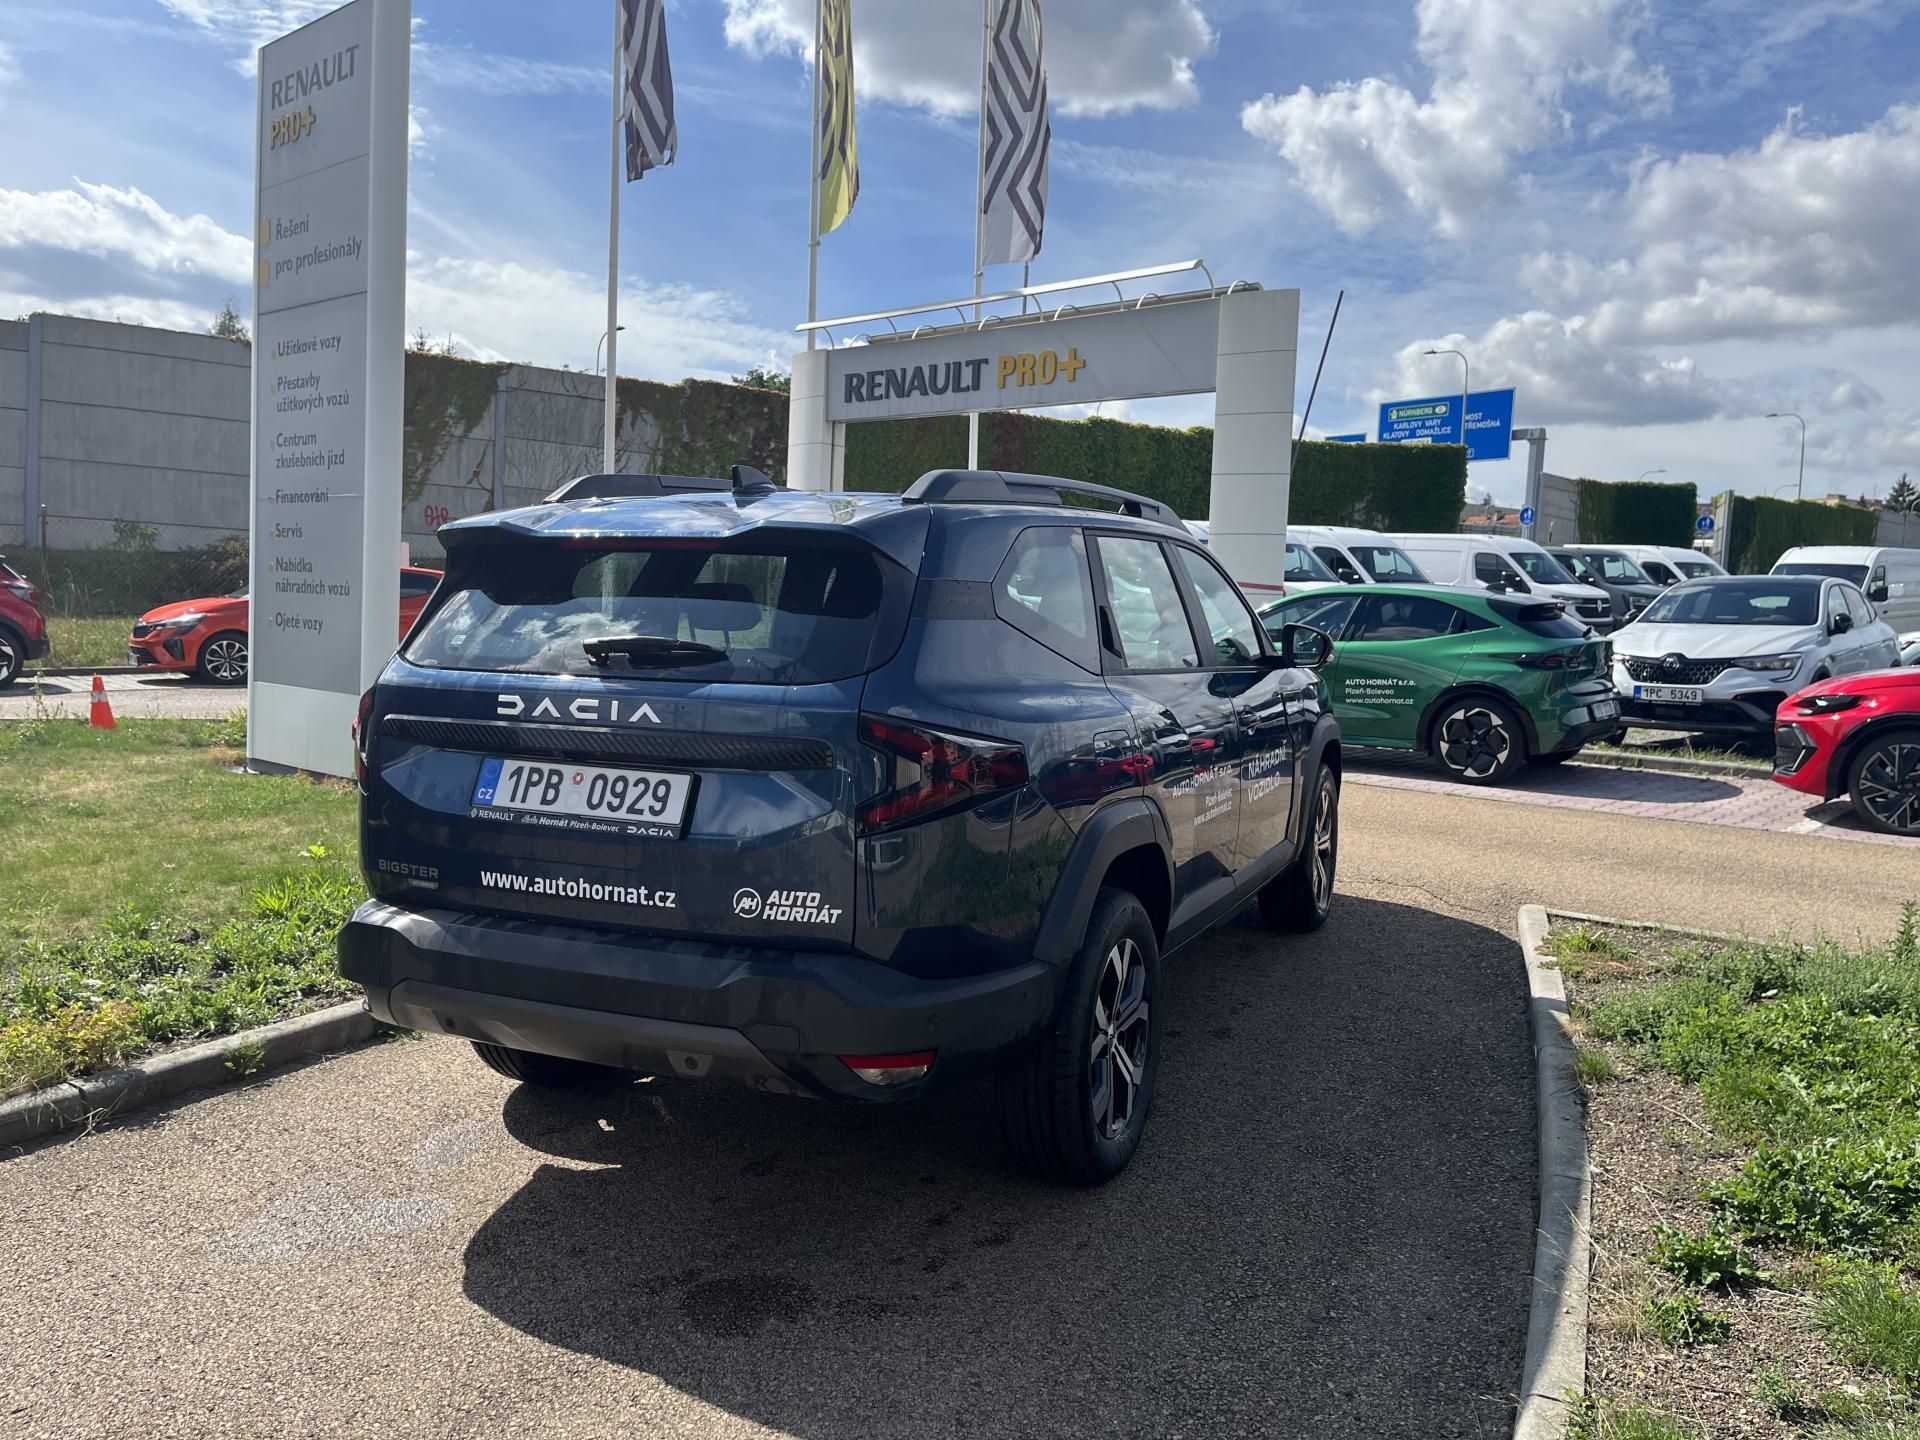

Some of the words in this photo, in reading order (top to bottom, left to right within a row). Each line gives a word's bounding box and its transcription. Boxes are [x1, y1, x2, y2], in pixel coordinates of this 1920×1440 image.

[271, 44, 360, 110] RENAULT
[269, 105, 316, 150] PRO+
[276, 213, 310, 240] Řešení
[275, 259, 293, 280] pro
[295, 236, 362, 275] profesionály
[277, 336, 318, 356] Užitkové
[320, 336, 341, 352] vozy
[277, 371, 321, 392] Přestavby
[844, 358, 989, 402] RENAULT
[996, 347, 1086, 388] PRO+
[276, 392, 324, 414] užitkových
[326, 388, 350, 407] vozů
[1398, 406, 1433, 417] NÜRNBERG
[1393, 420, 1423, 430] KARLOVY
[1424, 418, 1442, 427] VARY
[276, 433, 317, 448] Centrum
[1382, 430, 1410, 440] KLATOVY
[275, 450, 325, 469] zkušebních
[276, 487, 329, 504] Financování
[275, 523, 303, 538] Servis
[275, 578, 326, 595] náhradních
[327, 581, 350, 597] vozů
[275, 612, 300, 632] Ojeté
[302, 619, 323, 636] vozy
[1345, 687, 1395, 695] Plzeň-Bolevec
[1366, 678, 1398, 686] HORNÁT
[1643, 688, 1663, 699] 1PC
[1670, 690, 1697, 701] 5349
[497, 694, 662, 724] DACIA
[1248, 739, 1287, 780] NÁHRADNÍ
[508, 765, 564, 806] 1PB
[586, 773, 672, 817] 0929
[1172, 778, 1190, 800] AUTO
[1190, 764, 1218, 790] HORNÁT
[1247, 770, 1280, 804] VOZIDLO
[477, 788, 493, 800] CZ
[478, 809, 514, 821] RENAULT
[538, 816, 569, 828] Hornát
[569, 820, 621, 833] Plzeň-Bolevec
[626, 825, 674, 837] DACIA
[378, 858, 439, 879] BIGSTER
[480, 870, 677, 908] www.autohornat.cz
[766, 890, 821, 907] AUTO
[762, 905, 843, 924] HORNÁT
